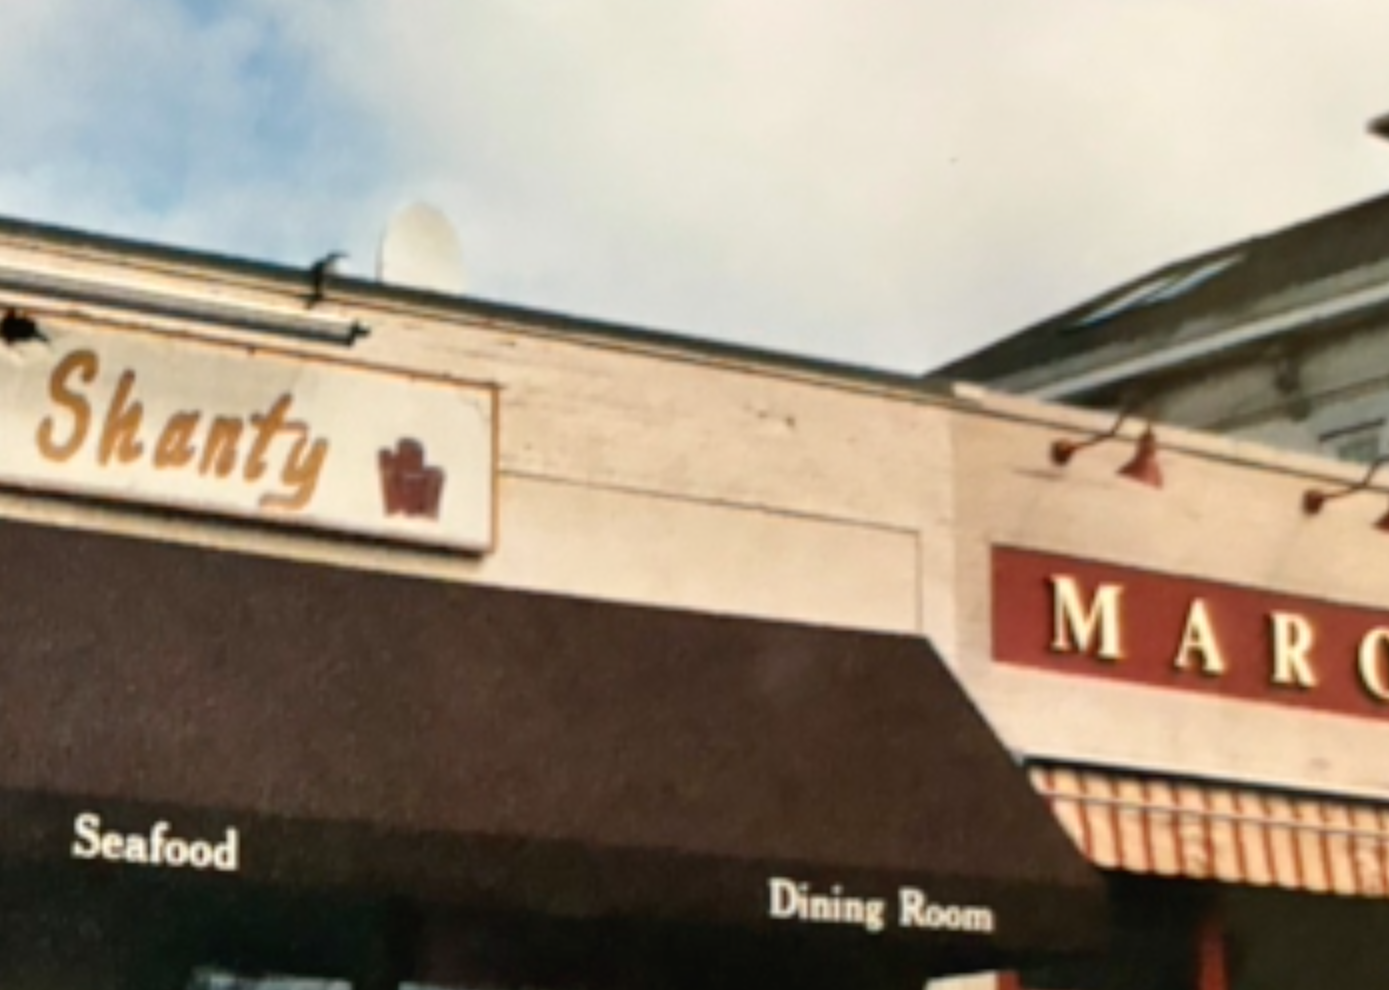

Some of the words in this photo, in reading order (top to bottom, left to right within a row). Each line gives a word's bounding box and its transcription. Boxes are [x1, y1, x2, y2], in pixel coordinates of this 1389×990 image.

[35, 349, 329, 509] Shanty
[71, 812, 241, 871] Seafood
[768, 876, 886, 933] Dining
[898, 886, 995, 933] Room
